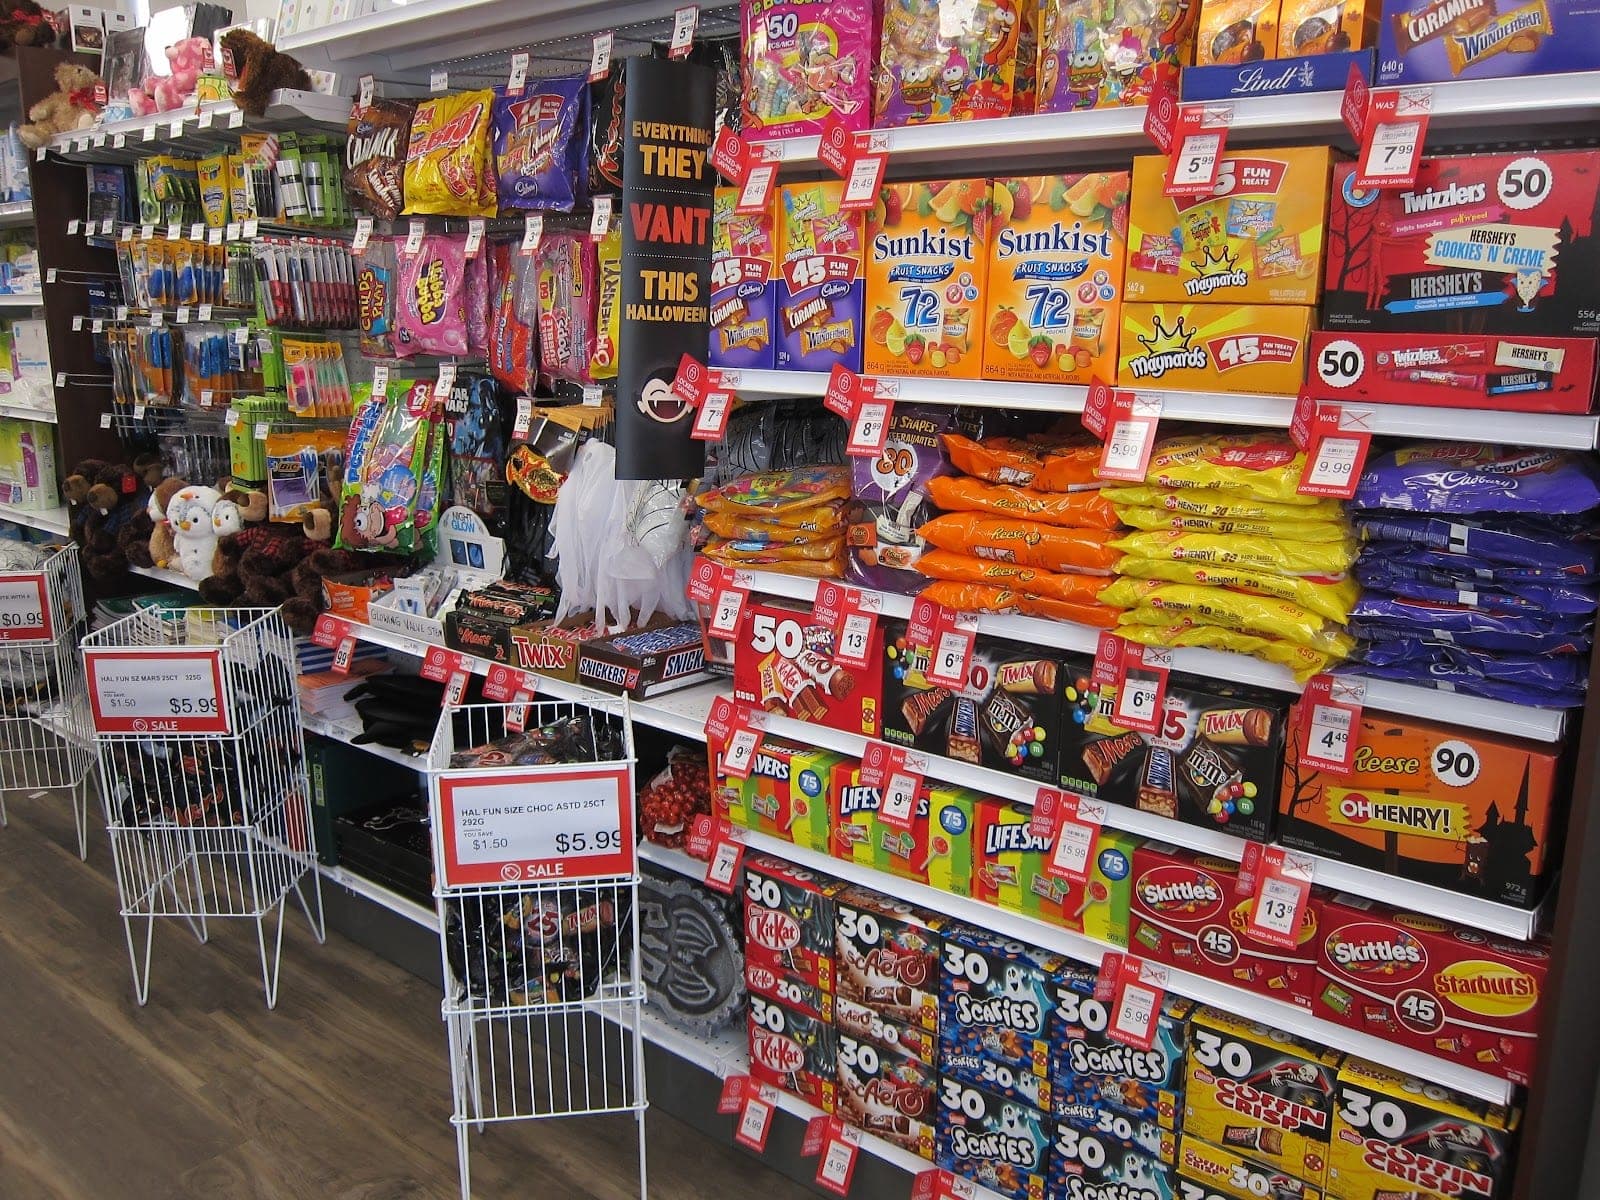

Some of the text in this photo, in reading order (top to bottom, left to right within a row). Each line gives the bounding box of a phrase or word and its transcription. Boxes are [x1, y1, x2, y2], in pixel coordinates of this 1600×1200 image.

[767, 14, 799, 39] 50
[1456, 10, 1542, 61] WUNDERBAR
[1230, 61, 1298, 95] Lindt
[1381, 61, 1404, 74] 640 g
[1375, 101, 1396, 110] WAS
[632, 121, 711, 146] EVERYTHING
[639, 145, 707, 179] THEY
[715, 150, 743, 171] LOCKED-IN
[716, 158, 739, 178] SAVINGS
[851, 177, 873, 191] 6.49
[1242, 178, 1270, 186] TREATS
[1243, 168, 1270, 178] FUN
[1357, 177, 1414, 186] LOCKED-IN SAVINGS
[1503, 168, 1547, 198] 50
[746, 183, 766, 197] 6.49
[1400, 182, 1486, 214] Twizzlers
[629, 203, 711, 246] VANT
[874, 227, 973, 260] Sunkist
[999, 222, 1112, 258] Sunkist
[1469, 229, 1516, 246] HERSHEY'S
[1434, 240, 1482, 260] COOKIES
[1505, 247, 1545, 267] CREME
[793, 258, 849, 287] 45 FUN
[890, 262, 950, 275] FRUIT SNACKS
[640, 270, 699, 302] THIS
[1410, 272, 1483, 298] HERSHEY'S
[626, 304, 707, 323] HALLOWEEN
[790, 296, 827, 328] CARAMILK
[901, 286, 940, 327] 72
[1026, 284, 1070, 327] 72
[1577, 310, 1594, 319] 556
[1218, 338, 1259, 364] 45
[1392, 349, 1440, 364] Twizzlers
[1511, 348, 1548, 361] HERSHEY'S
[984, 364, 1000, 374] 864
[1322, 351, 1358, 377] 50
[1501, 373, 1538, 386] HERSHEY'S
[899, 415, 937, 433] SHAPES
[1320, 414, 1337, 423] WAS
[1111, 443, 1138, 457] 5.99
[1319, 461, 1352, 475] 9.99
[1437, 470, 1518, 490] Cadbury
[451, 511, 472, 522] NIGHT
[1177, 501, 1208, 514] HENRY!
[451, 521, 475, 533] GLOW
[2, 612, 44, 627] $0.99
[371, 608, 400, 626] GLOWING
[459, 630, 492, 645] Mars
[751, 614, 803, 659] 50
[513, 637, 566, 669] Twix
[804, 651, 833, 675] Aero
[580, 658, 626, 685] SNICKERS
[776, 662, 800, 690] KitKat
[1002, 663, 1036, 686] Twix
[110, 698, 136, 708] $1.50
[169, 698, 218, 714] $5.99
[151, 721, 178, 731] SALE
[1205, 711, 1245, 734] Twix
[1300, 758, 1349, 774] LOCKED-IN SAVINGS
[1354, 747, 1420, 774] Reese
[1437, 748, 1475, 778] 90
[801, 772, 818, 789] 75
[461, 799, 606, 817] HAL FUN SIZE CHOC ASTD 25CT
[943, 811, 962, 827] 75
[1341, 801, 1450, 833] OH HENRY!
[462, 818, 485, 826] 292G
[472, 838, 508, 851] $1.50
[555, 829, 621, 855] $5.99
[986, 824, 1053, 855] LIFESAV
[1062, 843, 1087, 858] 15.99
[527, 863, 564, 878] SALE
[1103, 854, 1124, 872] 75
[746, 871, 783, 909] 30
[1144, 882, 1217, 904] Skittles
[1506, 882, 1521, 890] 972
[756, 913, 797, 944] KitKat
[838, 905, 880, 946] 30
[1203, 931, 1232, 954] 45
[1333, 940, 1420, 965] Skittles
[943, 942, 990, 986] 30
[1435, 972, 1537, 997] Starburst
[751, 998, 785, 1034] 30
[1055, 988, 1108, 1032] 30
[1124, 1009, 1150, 1025] 5.99
[1402, 994, 1436, 1021] 45
[760, 1036, 800, 1065] KitKat
[838, 1035, 879, 1075] 30
[1193, 1030, 1254, 1079] 30
[941, 1079, 987, 1121] 30
[1215, 1091, 1301, 1132] CRISP
[1216, 1077, 1327, 1130] COFFIN
[744, 1117, 762, 1131] 4.99
[1338, 1088, 1408, 1140] 30
[1055, 1124, 1106, 1169] 30
[828, 1159, 847, 1174] 4.99
[1362, 1152, 1464, 1196] CRISP
[1365, 1138, 1494, 1198] COFFIN
[1228, 1163, 1270, 1197] 30
